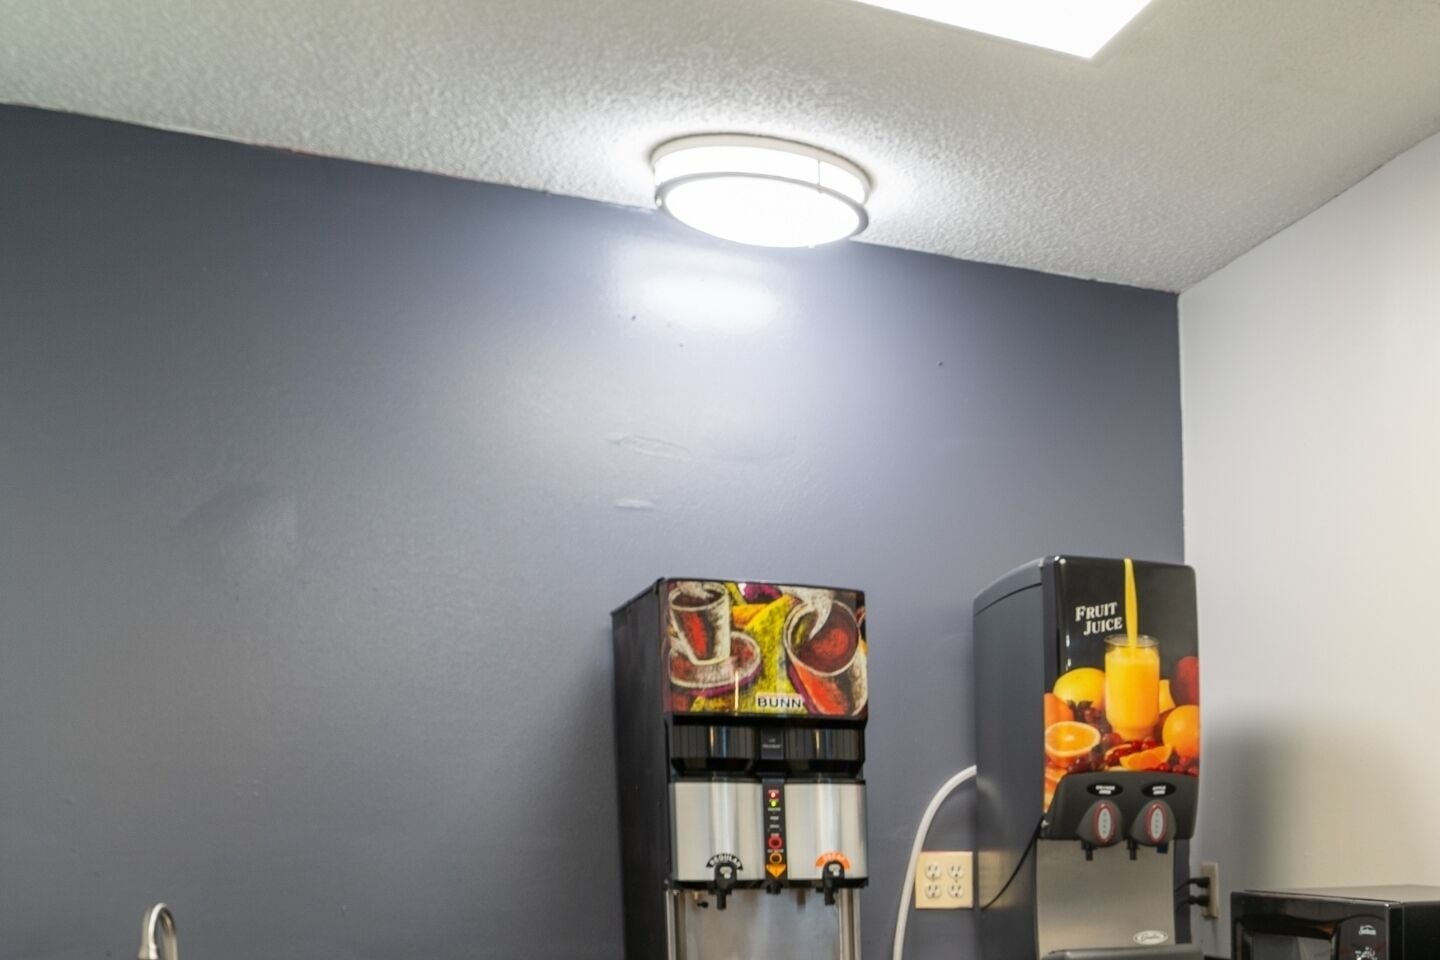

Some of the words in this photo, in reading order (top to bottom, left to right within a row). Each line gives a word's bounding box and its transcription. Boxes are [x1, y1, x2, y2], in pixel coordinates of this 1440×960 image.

[1075, 601, 1118, 622] FRUIT
[1083, 616, 1123, 636] JUICE
[757, 697, 801, 708] BUNN
